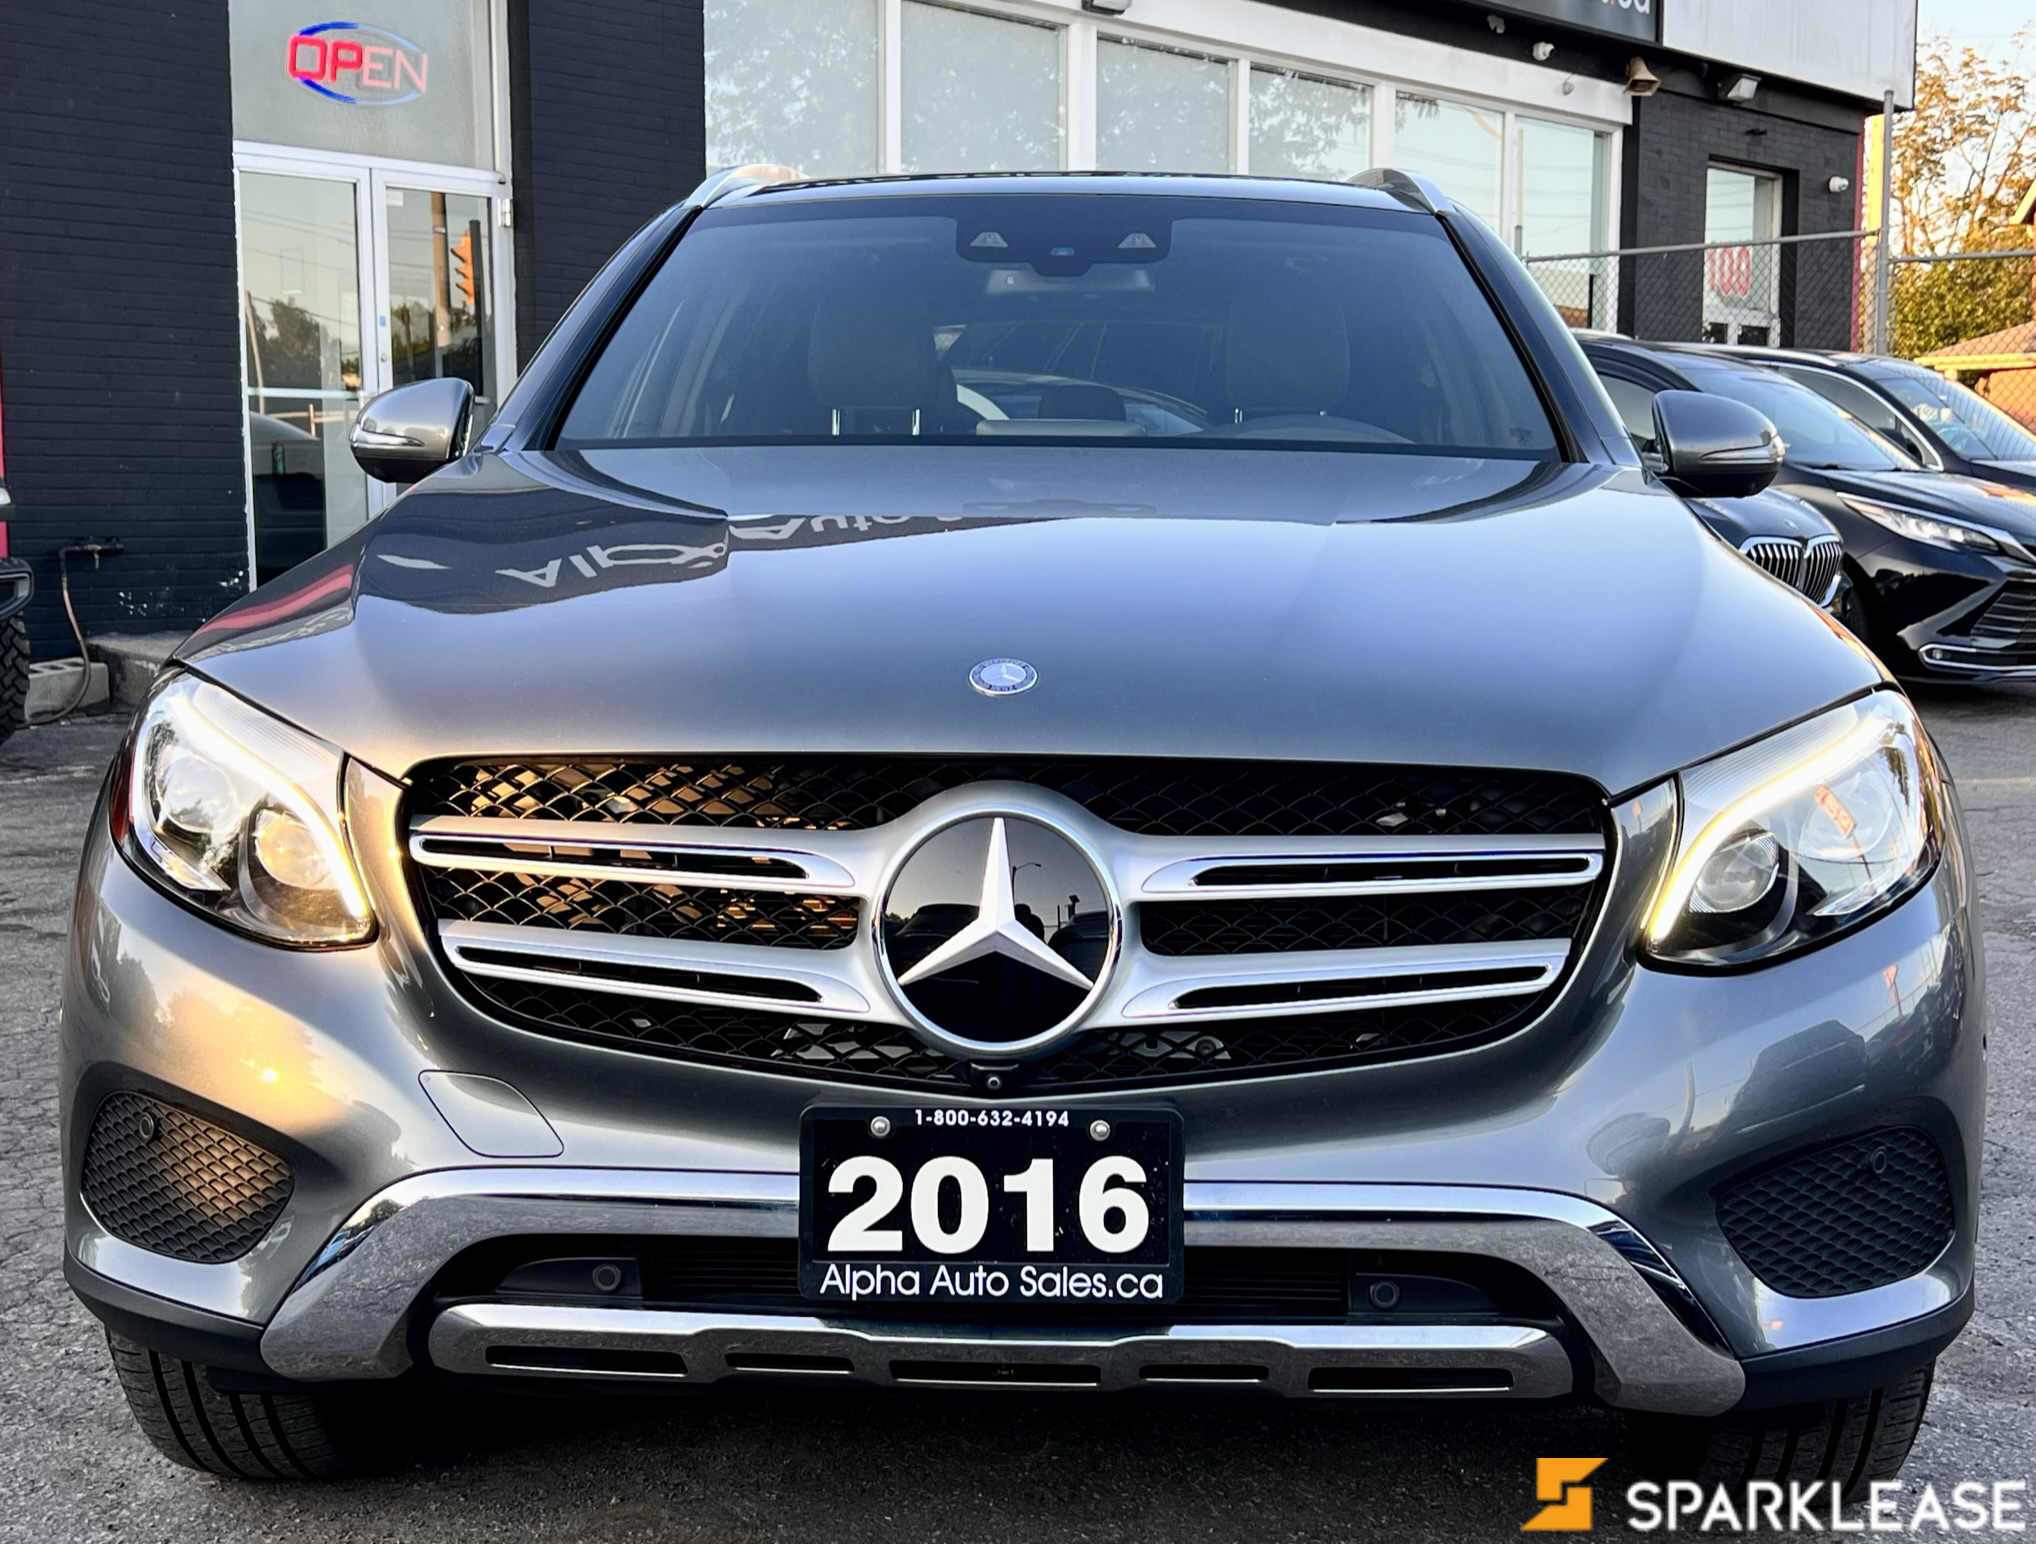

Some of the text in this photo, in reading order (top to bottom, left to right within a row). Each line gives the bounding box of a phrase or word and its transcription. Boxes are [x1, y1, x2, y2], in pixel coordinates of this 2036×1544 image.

[288, 34, 428, 94] OPEN
[915, 1109, 1069, 1127] 1-800-632-4194
[827, 1155, 1150, 1254] 2016
[819, 1264, 1164, 1300] Alpha Auto Sales.ca
